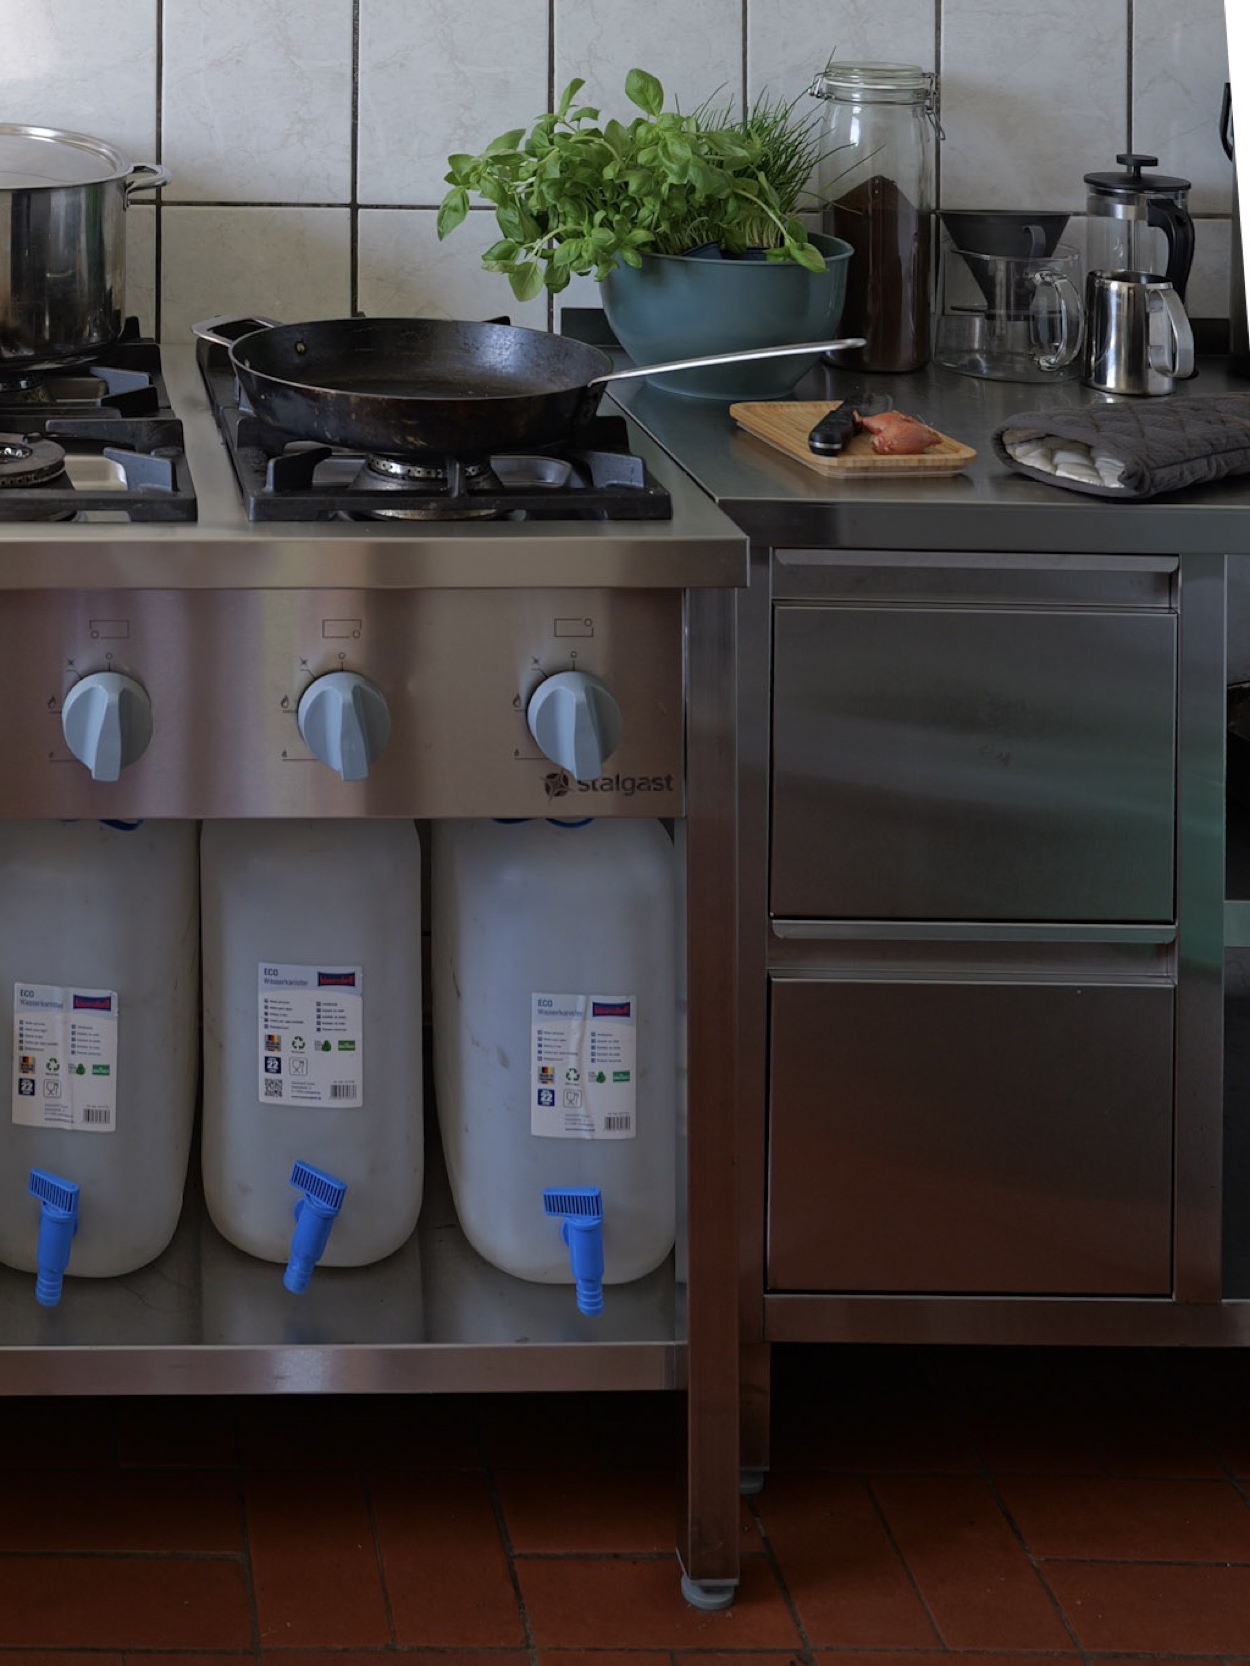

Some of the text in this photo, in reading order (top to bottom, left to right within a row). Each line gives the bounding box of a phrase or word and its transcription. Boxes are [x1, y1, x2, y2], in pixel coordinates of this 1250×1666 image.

[577, 773, 675, 796] stalgast
[264, 968, 278, 976] ECO
[20, 989, 34, 998] ECO
[538, 999, 553, 1007] ECO
